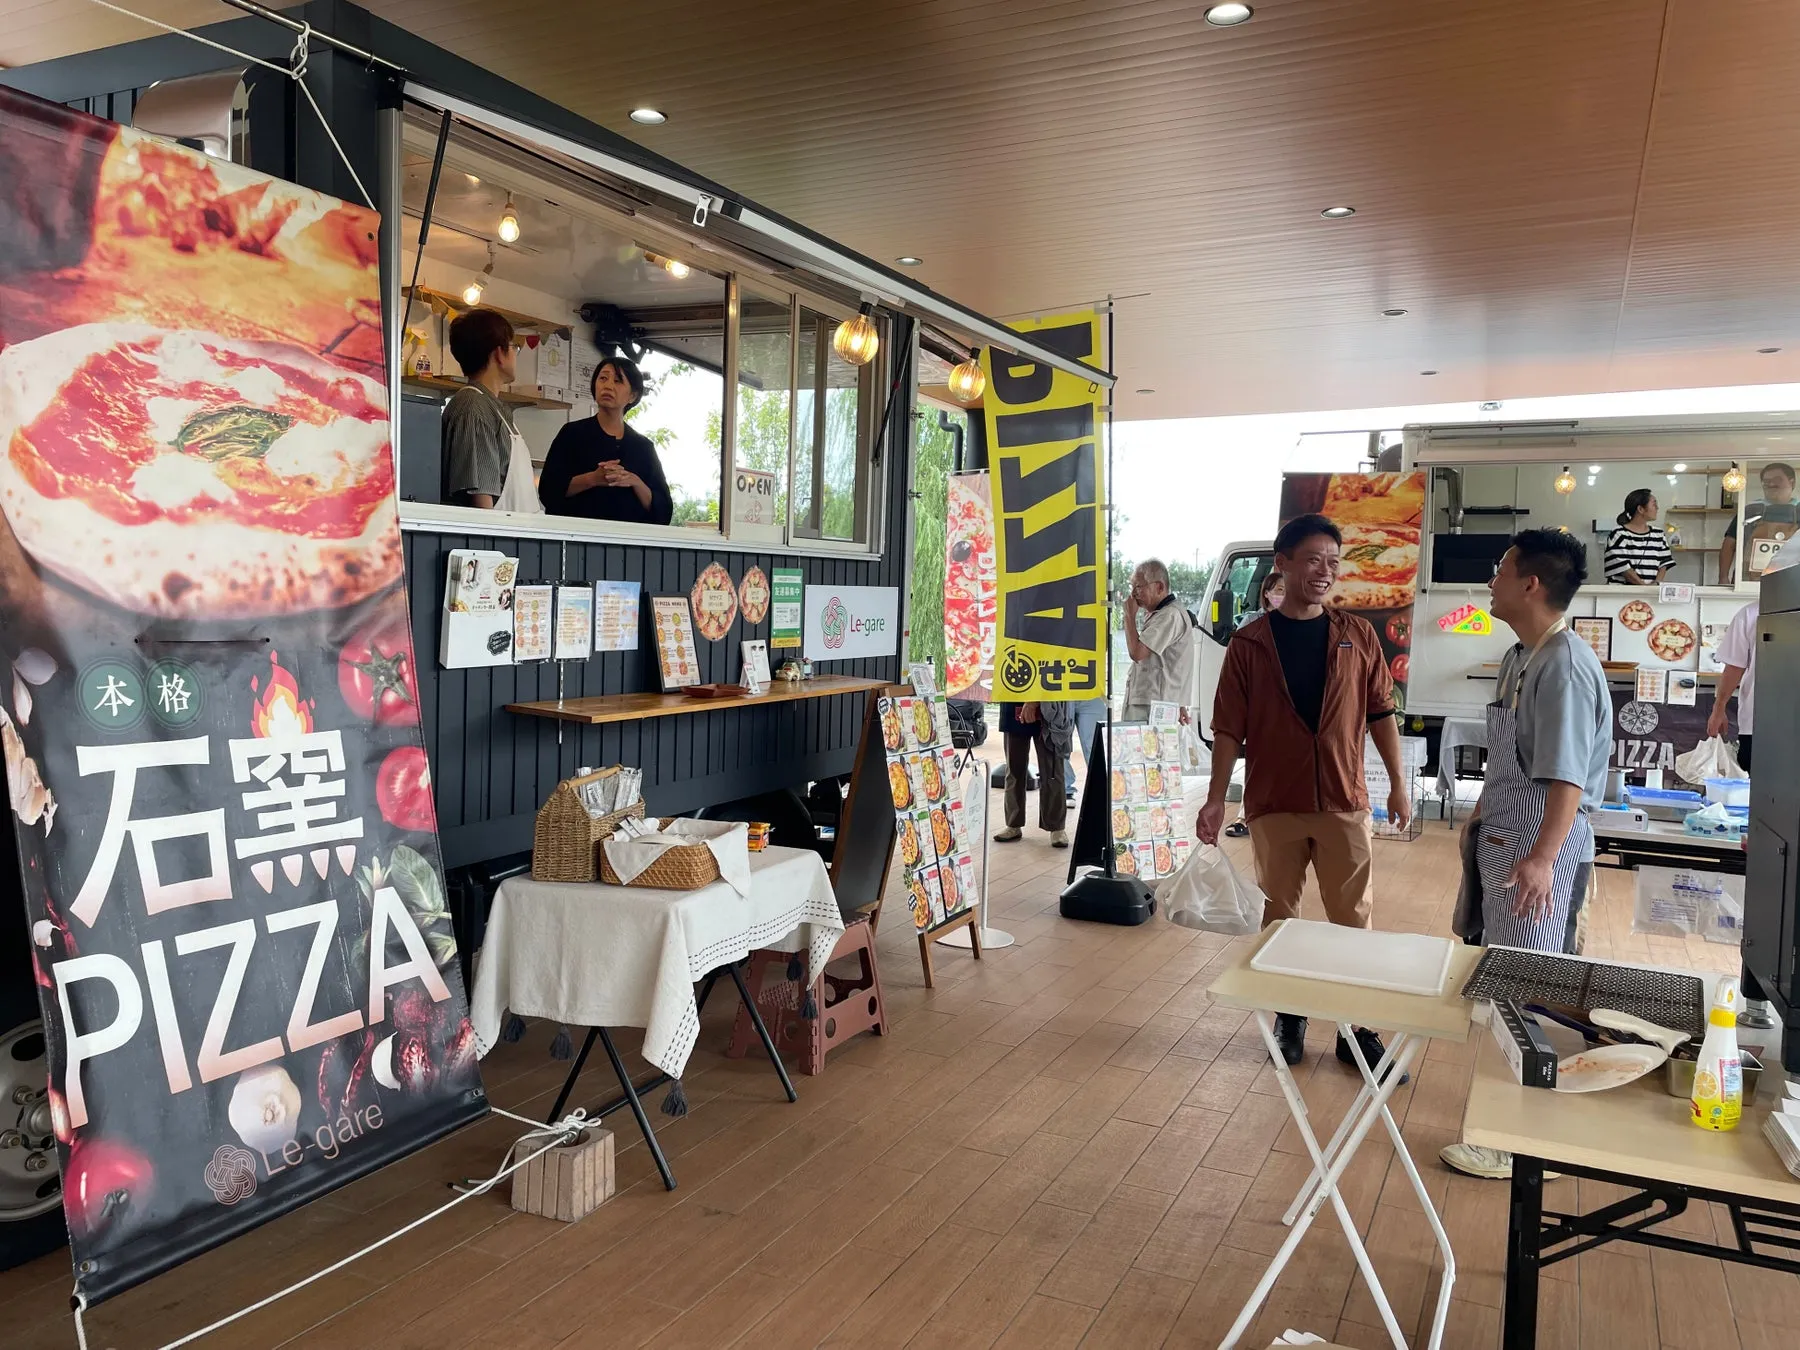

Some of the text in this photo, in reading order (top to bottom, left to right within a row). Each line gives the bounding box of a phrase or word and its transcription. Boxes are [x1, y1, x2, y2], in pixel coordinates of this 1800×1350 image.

[736, 475, 772, 496] OPEN
[850, 614, 885, 637] Le-gare
[1438, 604, 1478, 631] PIZZA
[94, 674, 192, 716] 本格
[69, 729, 364, 928] 石窯
[52, 886, 451, 1129] PIZZA
[261, 1104, 384, 1179] Le-gare
